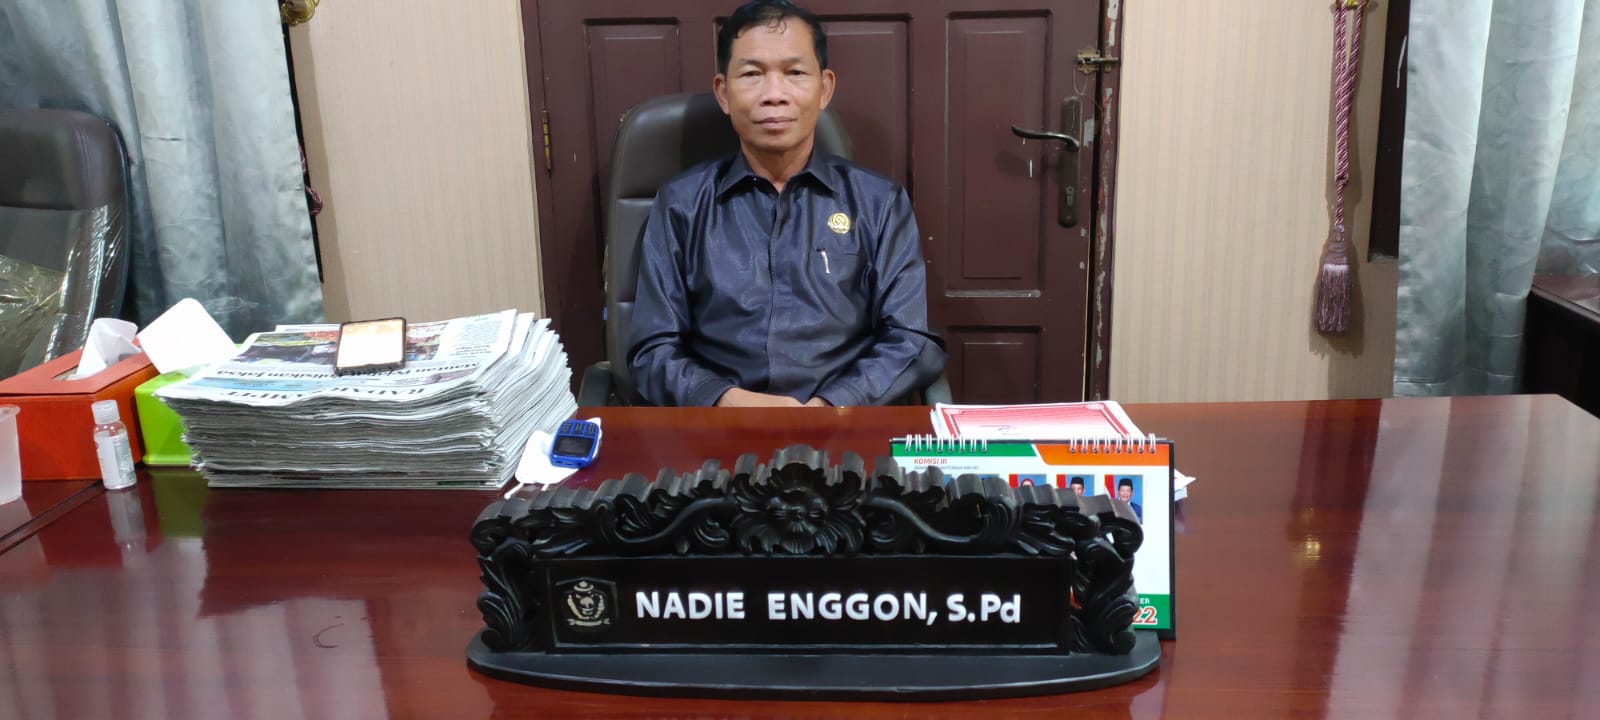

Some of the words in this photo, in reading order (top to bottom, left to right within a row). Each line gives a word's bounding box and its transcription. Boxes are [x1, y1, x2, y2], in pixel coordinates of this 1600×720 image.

[913, 457, 940, 465] KOMISI
[635, 591, 746, 620] NADIE
[767, 592, 938, 626] ENGGON,
[946, 592, 1022, 624] S.Pd
